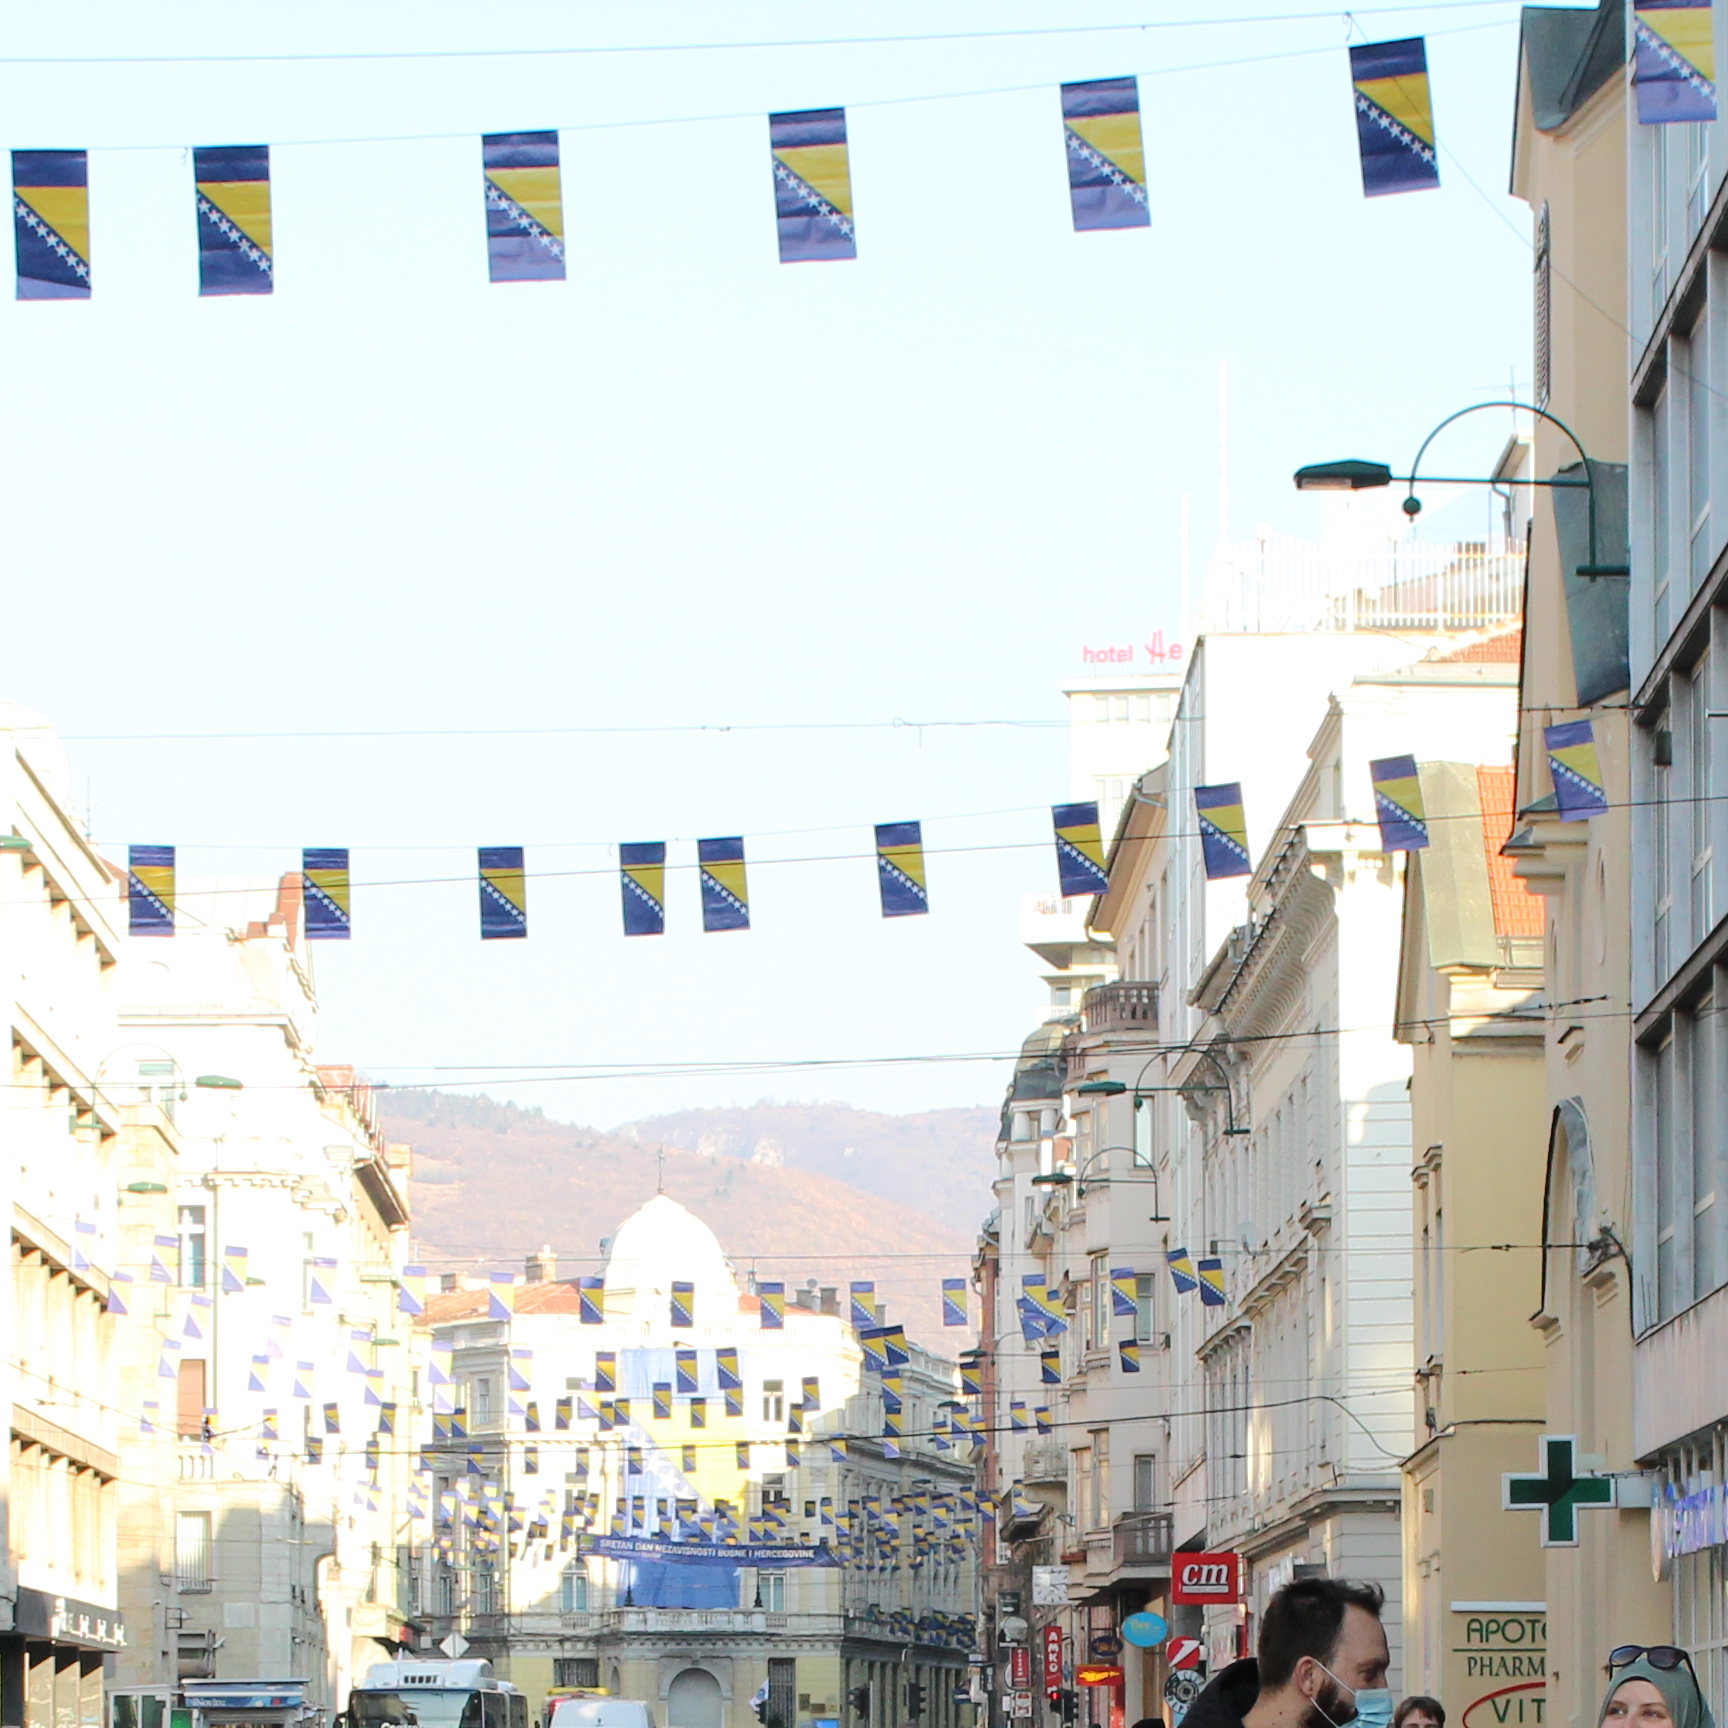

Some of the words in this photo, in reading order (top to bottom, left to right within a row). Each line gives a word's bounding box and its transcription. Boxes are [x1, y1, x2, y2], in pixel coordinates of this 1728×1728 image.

[1083, 645, 1133, 663] hotel
[599, 1539, 633, 1549] SRETAN
[635, 1542, 654, 1551] DAN
[655, 1544, 716, 1558] NEZAVISNOSTI
[754, 1549, 815, 1559] HERCEGOVINE
[1182, 1564, 1228, 1585] cm
[1467, 1618, 1547, 1643] APOT
[1048, 1632, 1059, 1672] AMKO
[1467, 1656, 1547, 1677] PHARM
